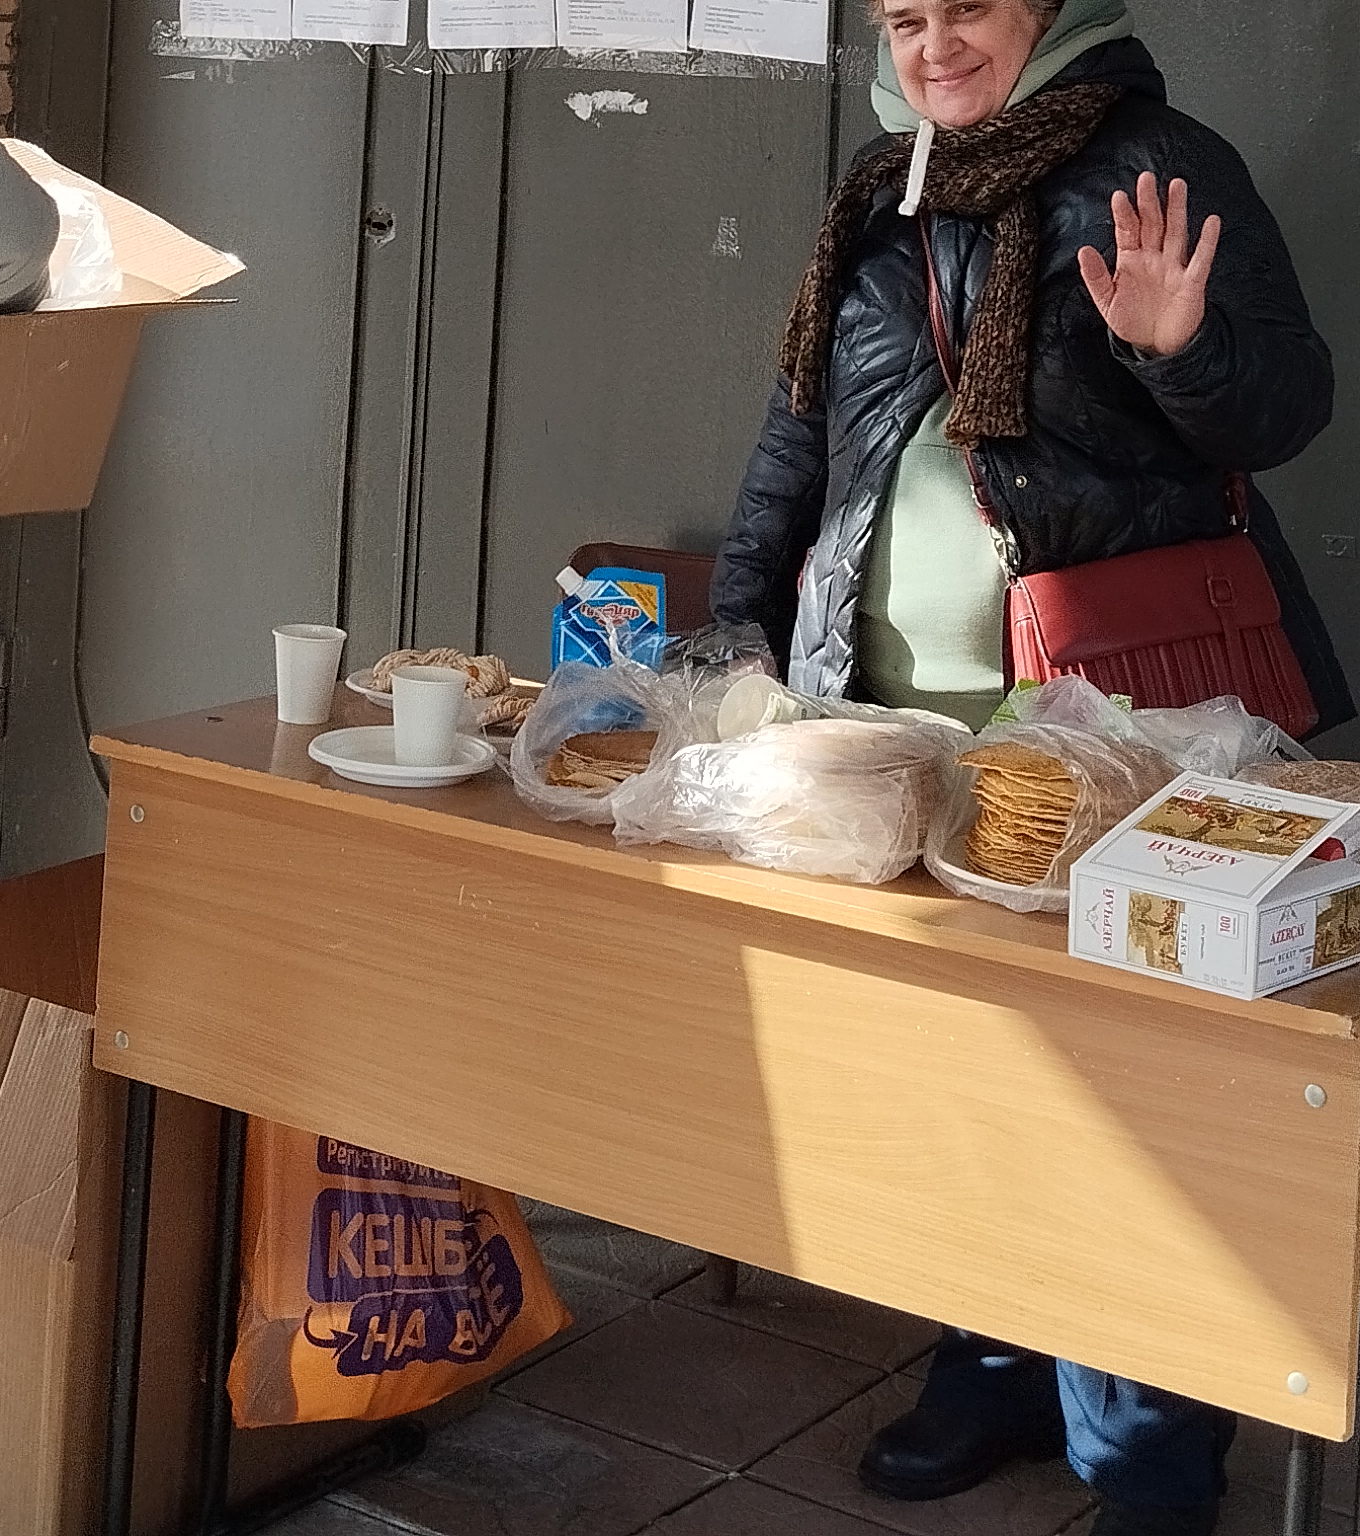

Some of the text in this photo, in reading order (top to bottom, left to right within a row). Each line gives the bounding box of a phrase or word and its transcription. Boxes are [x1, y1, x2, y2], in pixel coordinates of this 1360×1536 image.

[1146, 839, 1245, 867] АЗЕРЧАЙ
[1102, 887, 1115, 954] АЗЕРЧАЙ
[360, 1308, 427, 1361] НА
